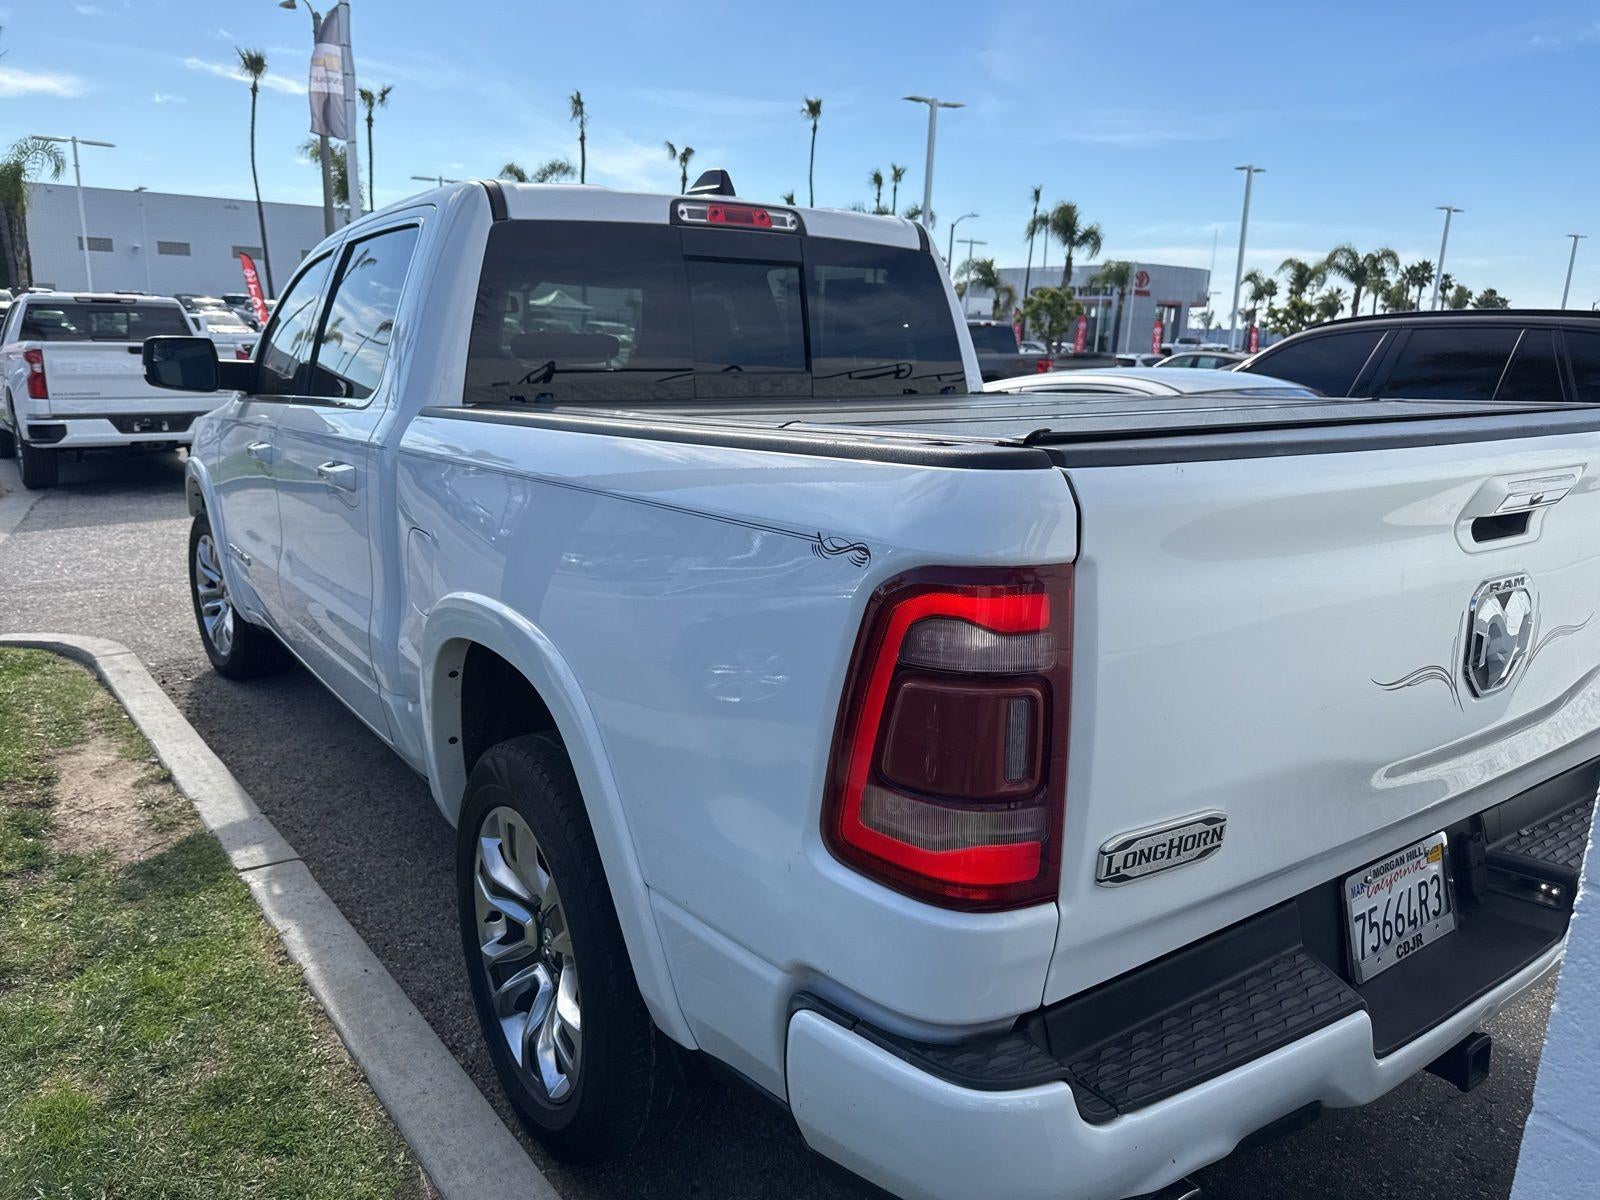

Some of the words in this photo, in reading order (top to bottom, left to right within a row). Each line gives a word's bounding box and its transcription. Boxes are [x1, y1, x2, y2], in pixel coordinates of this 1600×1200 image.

[1489, 577, 1525, 593] RAM
[1103, 824, 1227, 878] LONGHORN
[1372, 855, 1406, 878] MORGAN
[1406, 846, 1424, 862] HILL
[1350, 882, 1366, 899] MAR
[1366, 859, 1428, 899] California
[1354, 873, 1442, 961] 75664R3
[1395, 932, 1425, 959] CDJR
